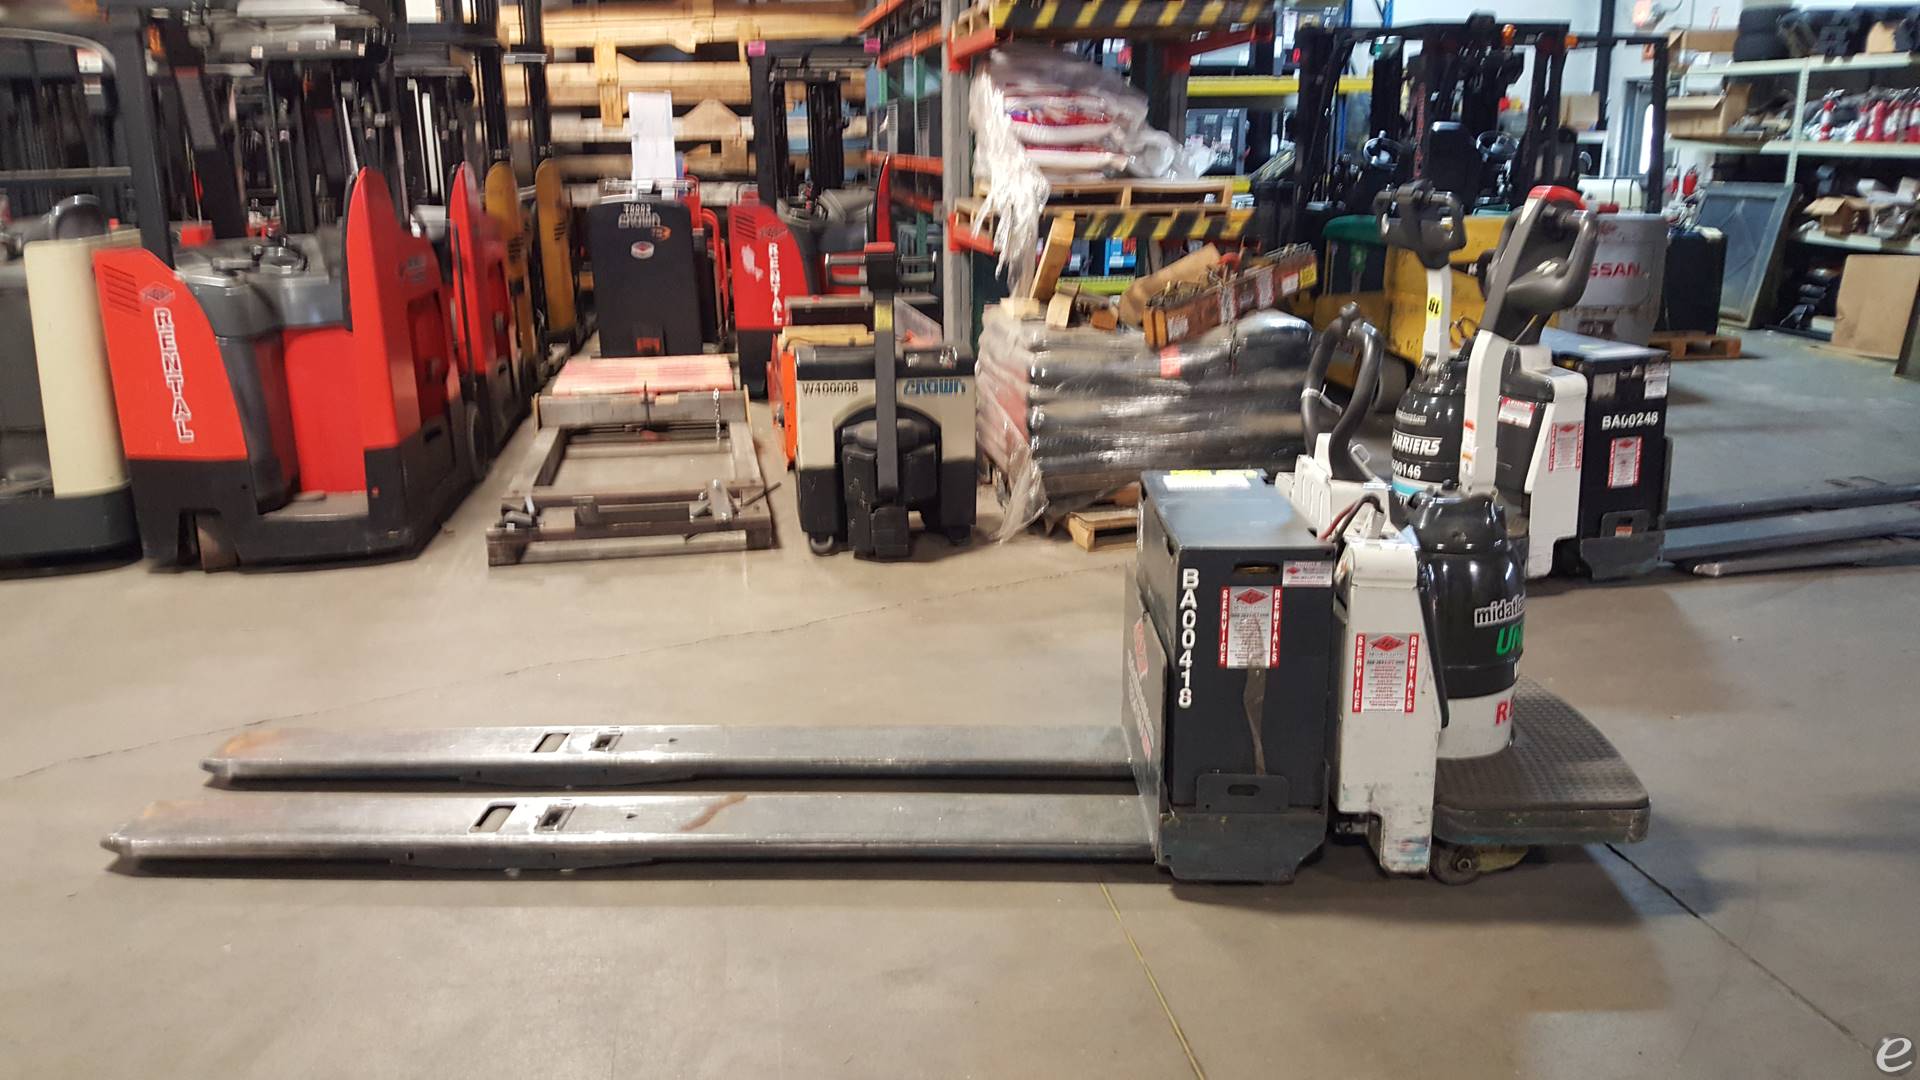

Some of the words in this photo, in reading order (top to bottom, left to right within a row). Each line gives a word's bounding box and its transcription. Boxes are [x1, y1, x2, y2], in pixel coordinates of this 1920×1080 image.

[768, 242, 784, 326] RENTAL
[154, 308, 194, 443] RENTAL
[802, 381, 859, 396] W400008
[903, 378, 966, 396] CROWN
[1392, 431, 1441, 457] ARRIERS
[1178, 568, 1200, 709] BA00418
[1220, 589, 1229, 665] SERVICE
[1272, 589, 1281, 663] RENTALS
[1353, 636, 1364, 709] SERVICE
[1406, 636, 1417, 710] RENTALS
